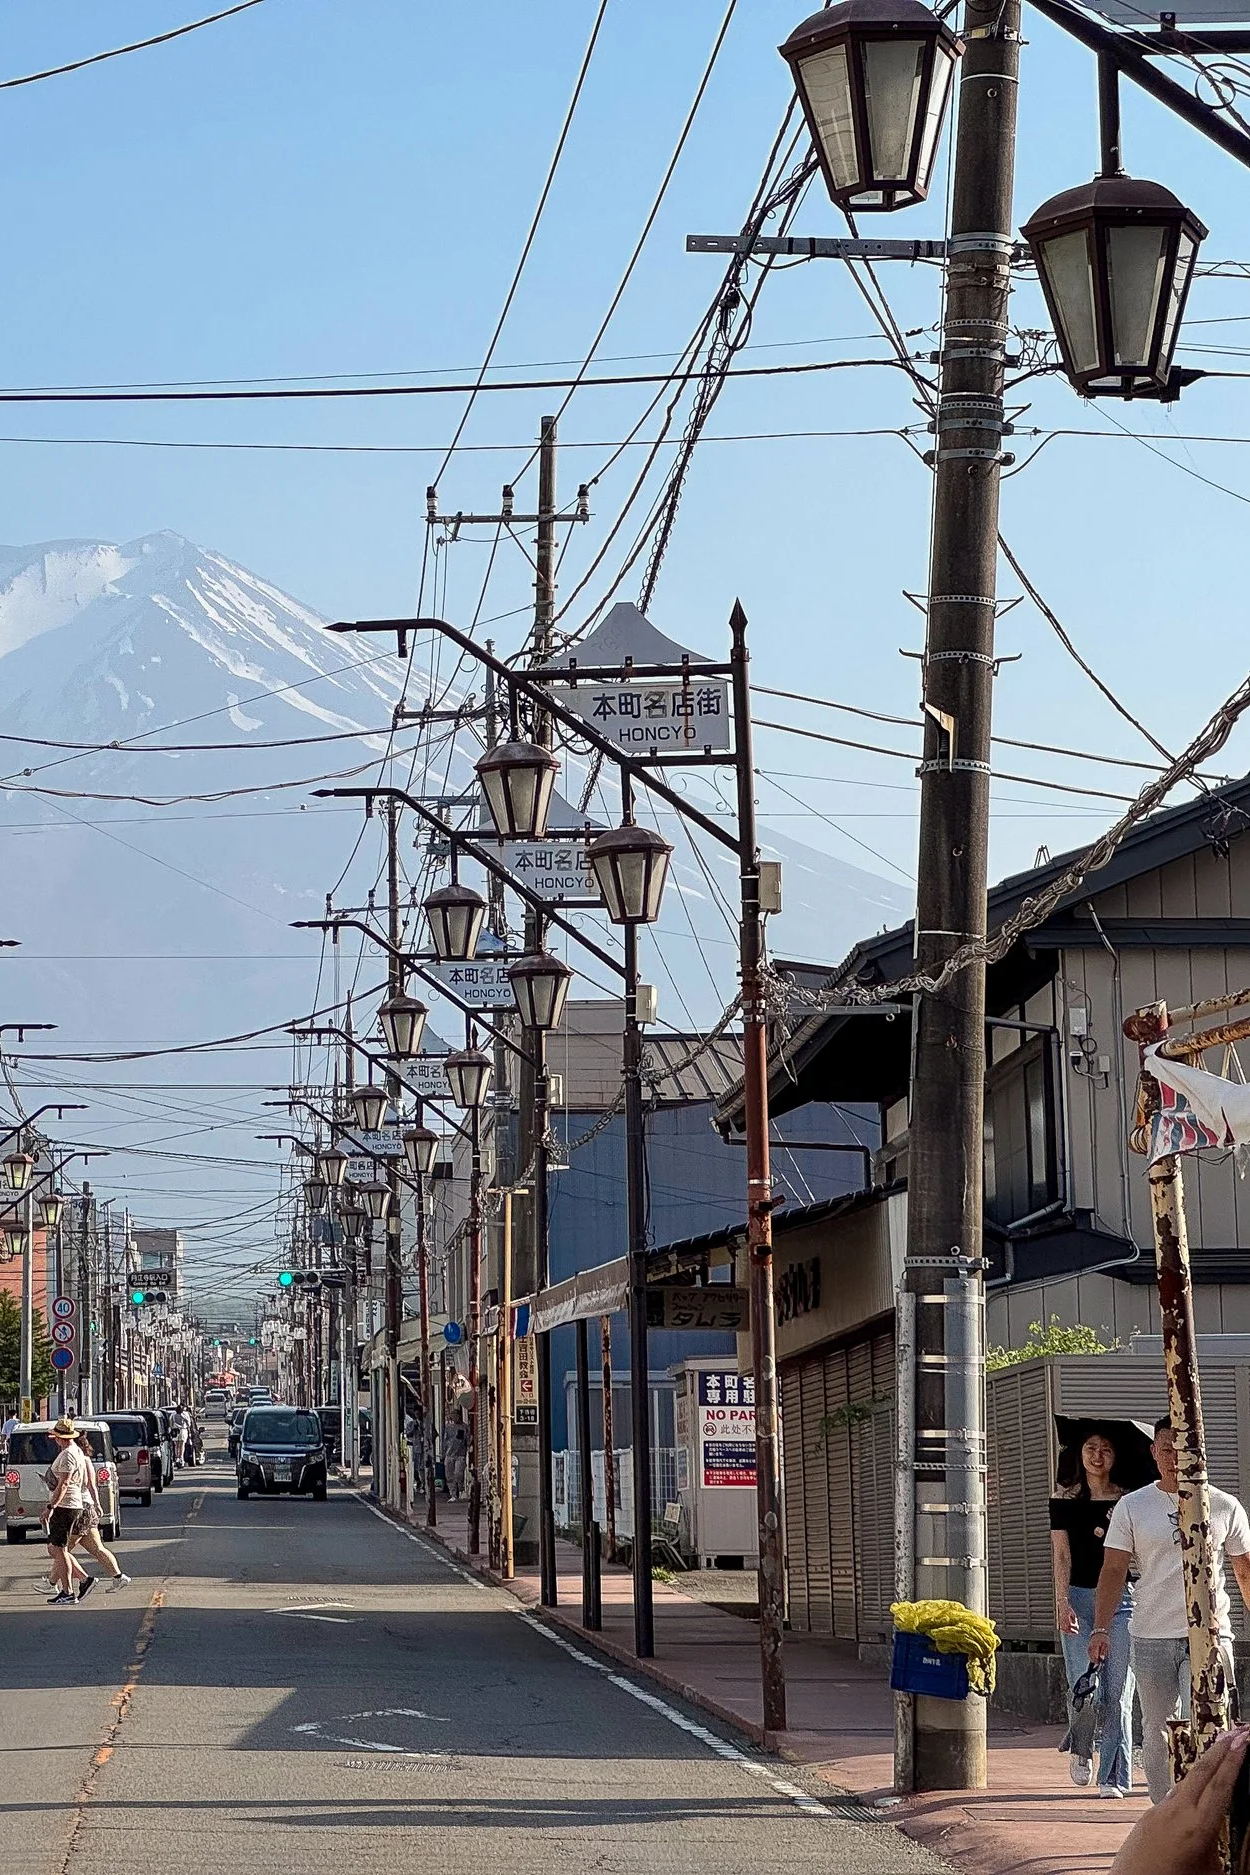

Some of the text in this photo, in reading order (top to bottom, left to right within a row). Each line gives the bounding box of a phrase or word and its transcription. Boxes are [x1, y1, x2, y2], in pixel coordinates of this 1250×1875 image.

[592, 688, 721, 721] 本町名店街
[515, 850, 592, 873] 本町名店
[449, 967, 510, 985] 本町名店
[407, 1065, 447, 1078] 本町名
[419, 1081, 449, 1089] HONCY
[57, 1302, 70, 1313] 40
[671, 1312, 741, 1327] タムラ
[519, 1336, 528, 1378] 士吉田教会
[706, 1374, 755, 1389] 本町名
[706, 1389, 755, 1404] 専用駐
[706, 1410, 726, 1420] NO
